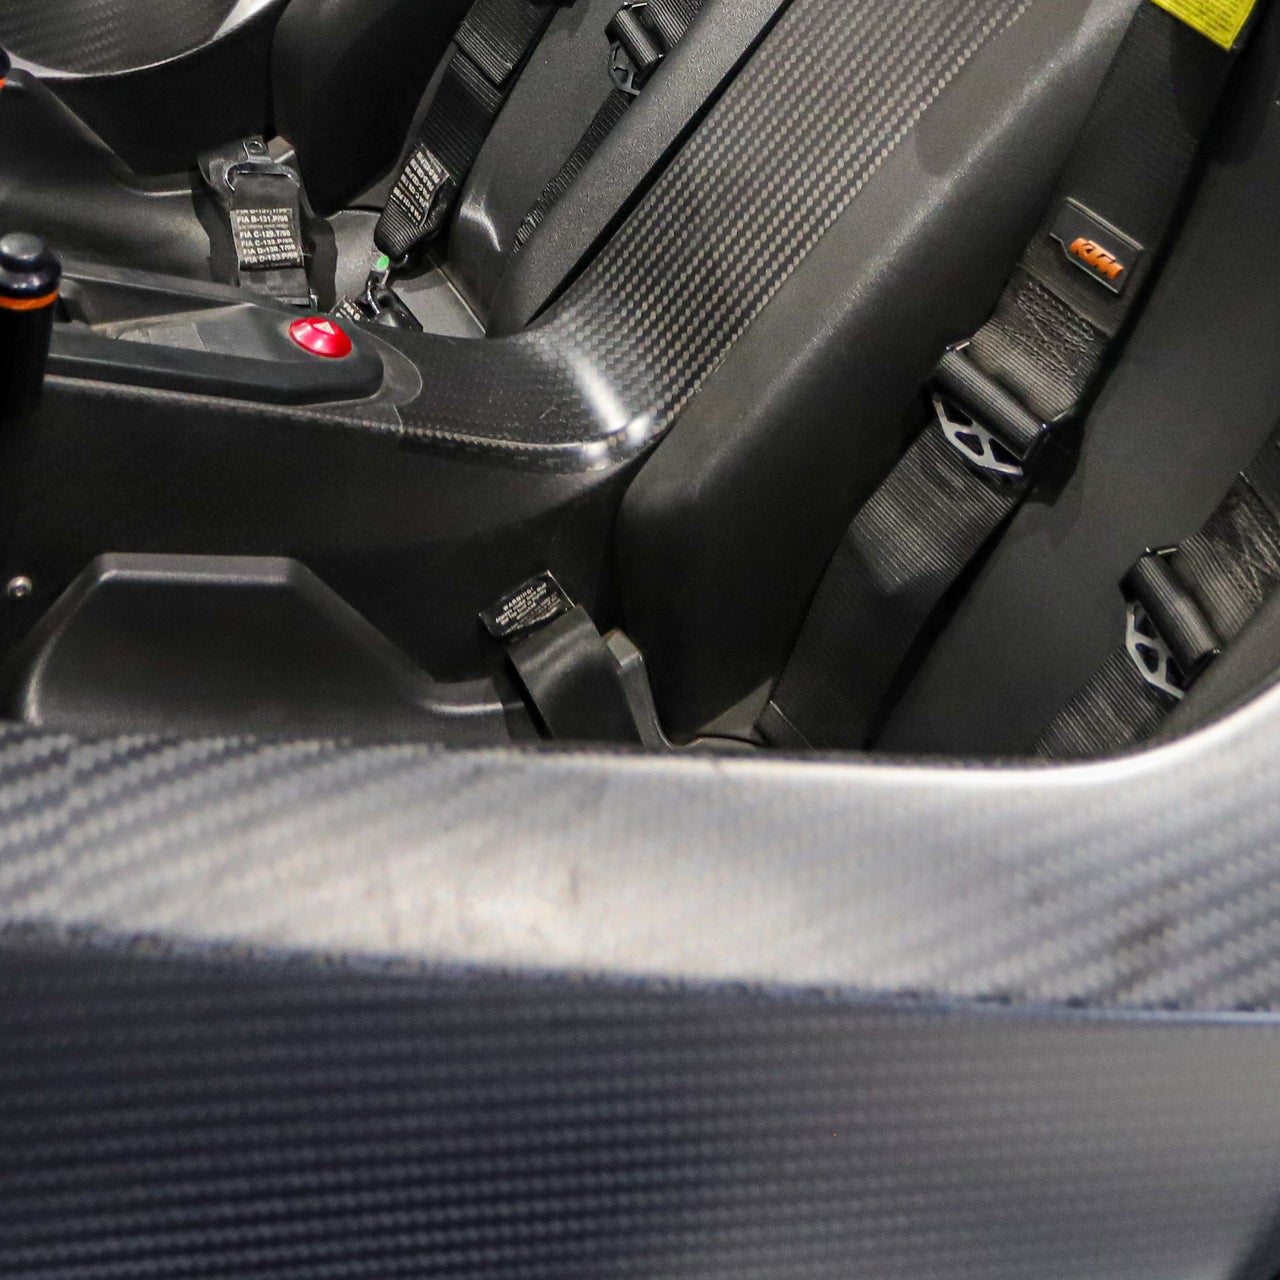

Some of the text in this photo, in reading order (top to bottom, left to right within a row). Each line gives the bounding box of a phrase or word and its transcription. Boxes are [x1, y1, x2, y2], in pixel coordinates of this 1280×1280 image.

[240, 230, 253, 238] FIA
[241, 240, 254, 248] FIA
[245, 256, 258, 264] FIA
[1070, 237, 1124, 280] KTM
